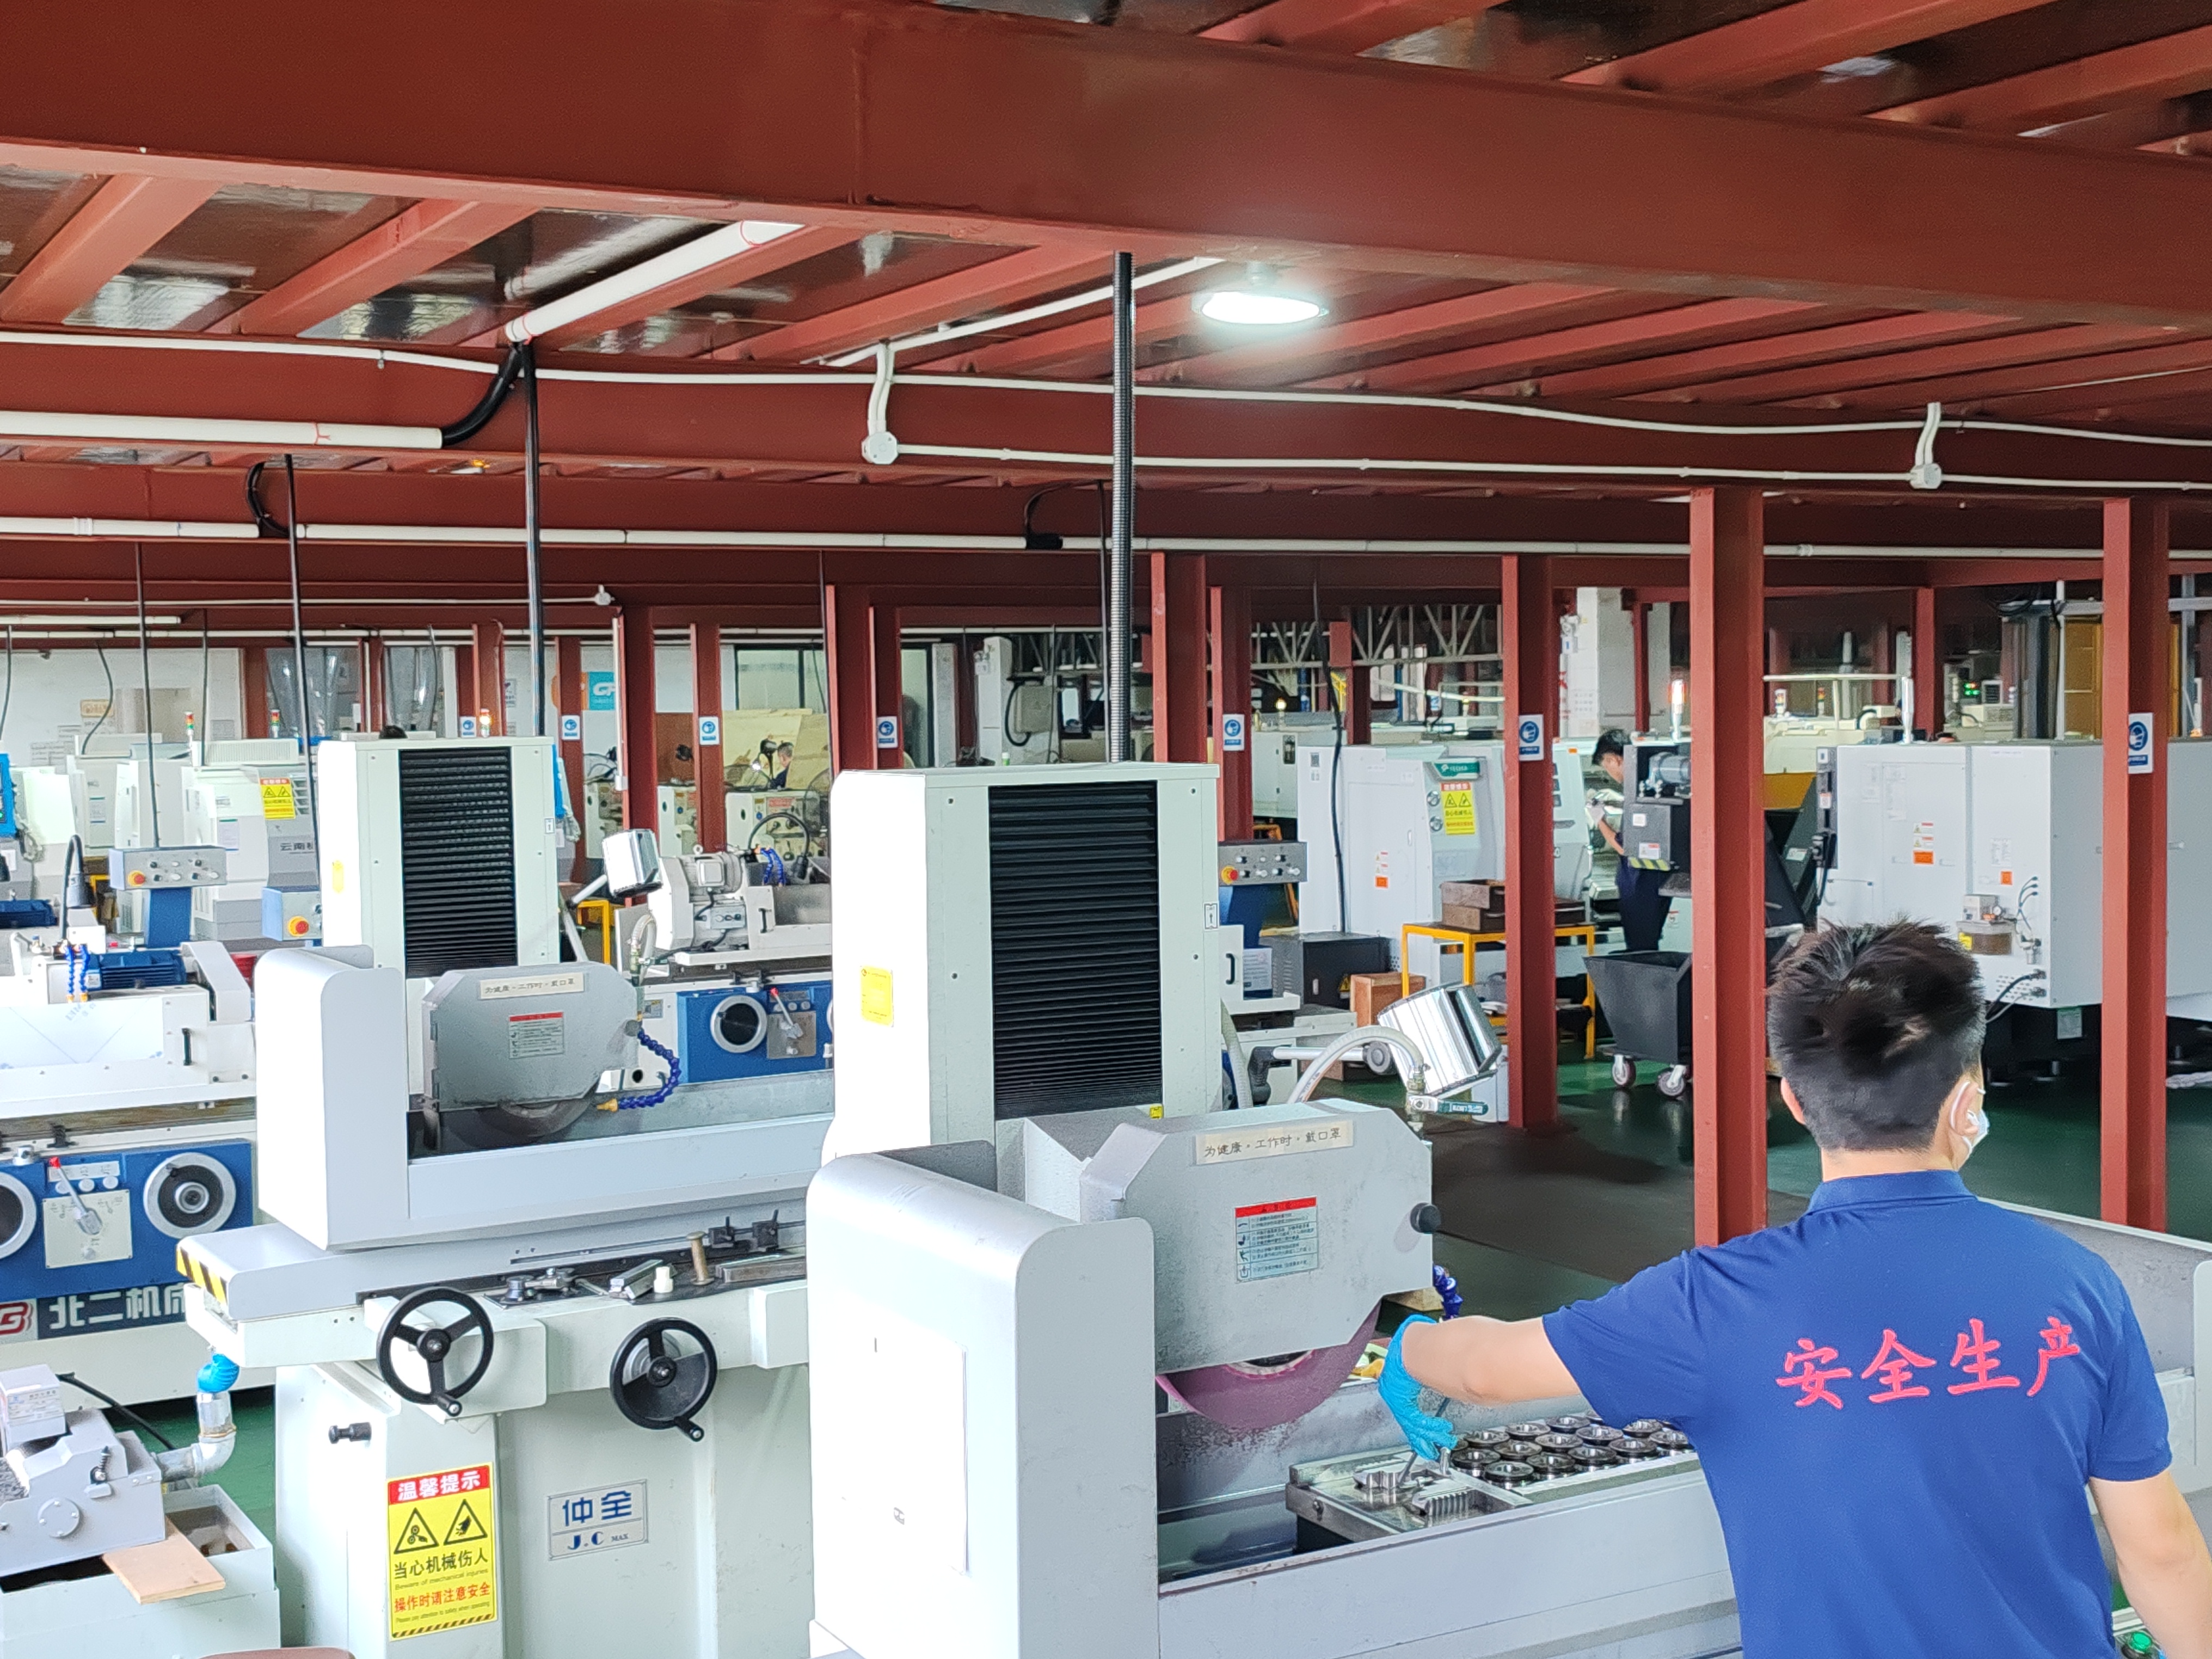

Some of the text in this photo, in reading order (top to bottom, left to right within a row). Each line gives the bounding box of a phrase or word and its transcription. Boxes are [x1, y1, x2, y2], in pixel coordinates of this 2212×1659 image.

[1775, 1316, 2081, 1410] 安全生产
[398, 1470, 481, 1501] 温馨提示
[562, 1490, 632, 1527] 仲全
[395, 1547, 488, 1579] 当心机械伤人
[394, 1581, 490, 1613] 操作时请注意安全
